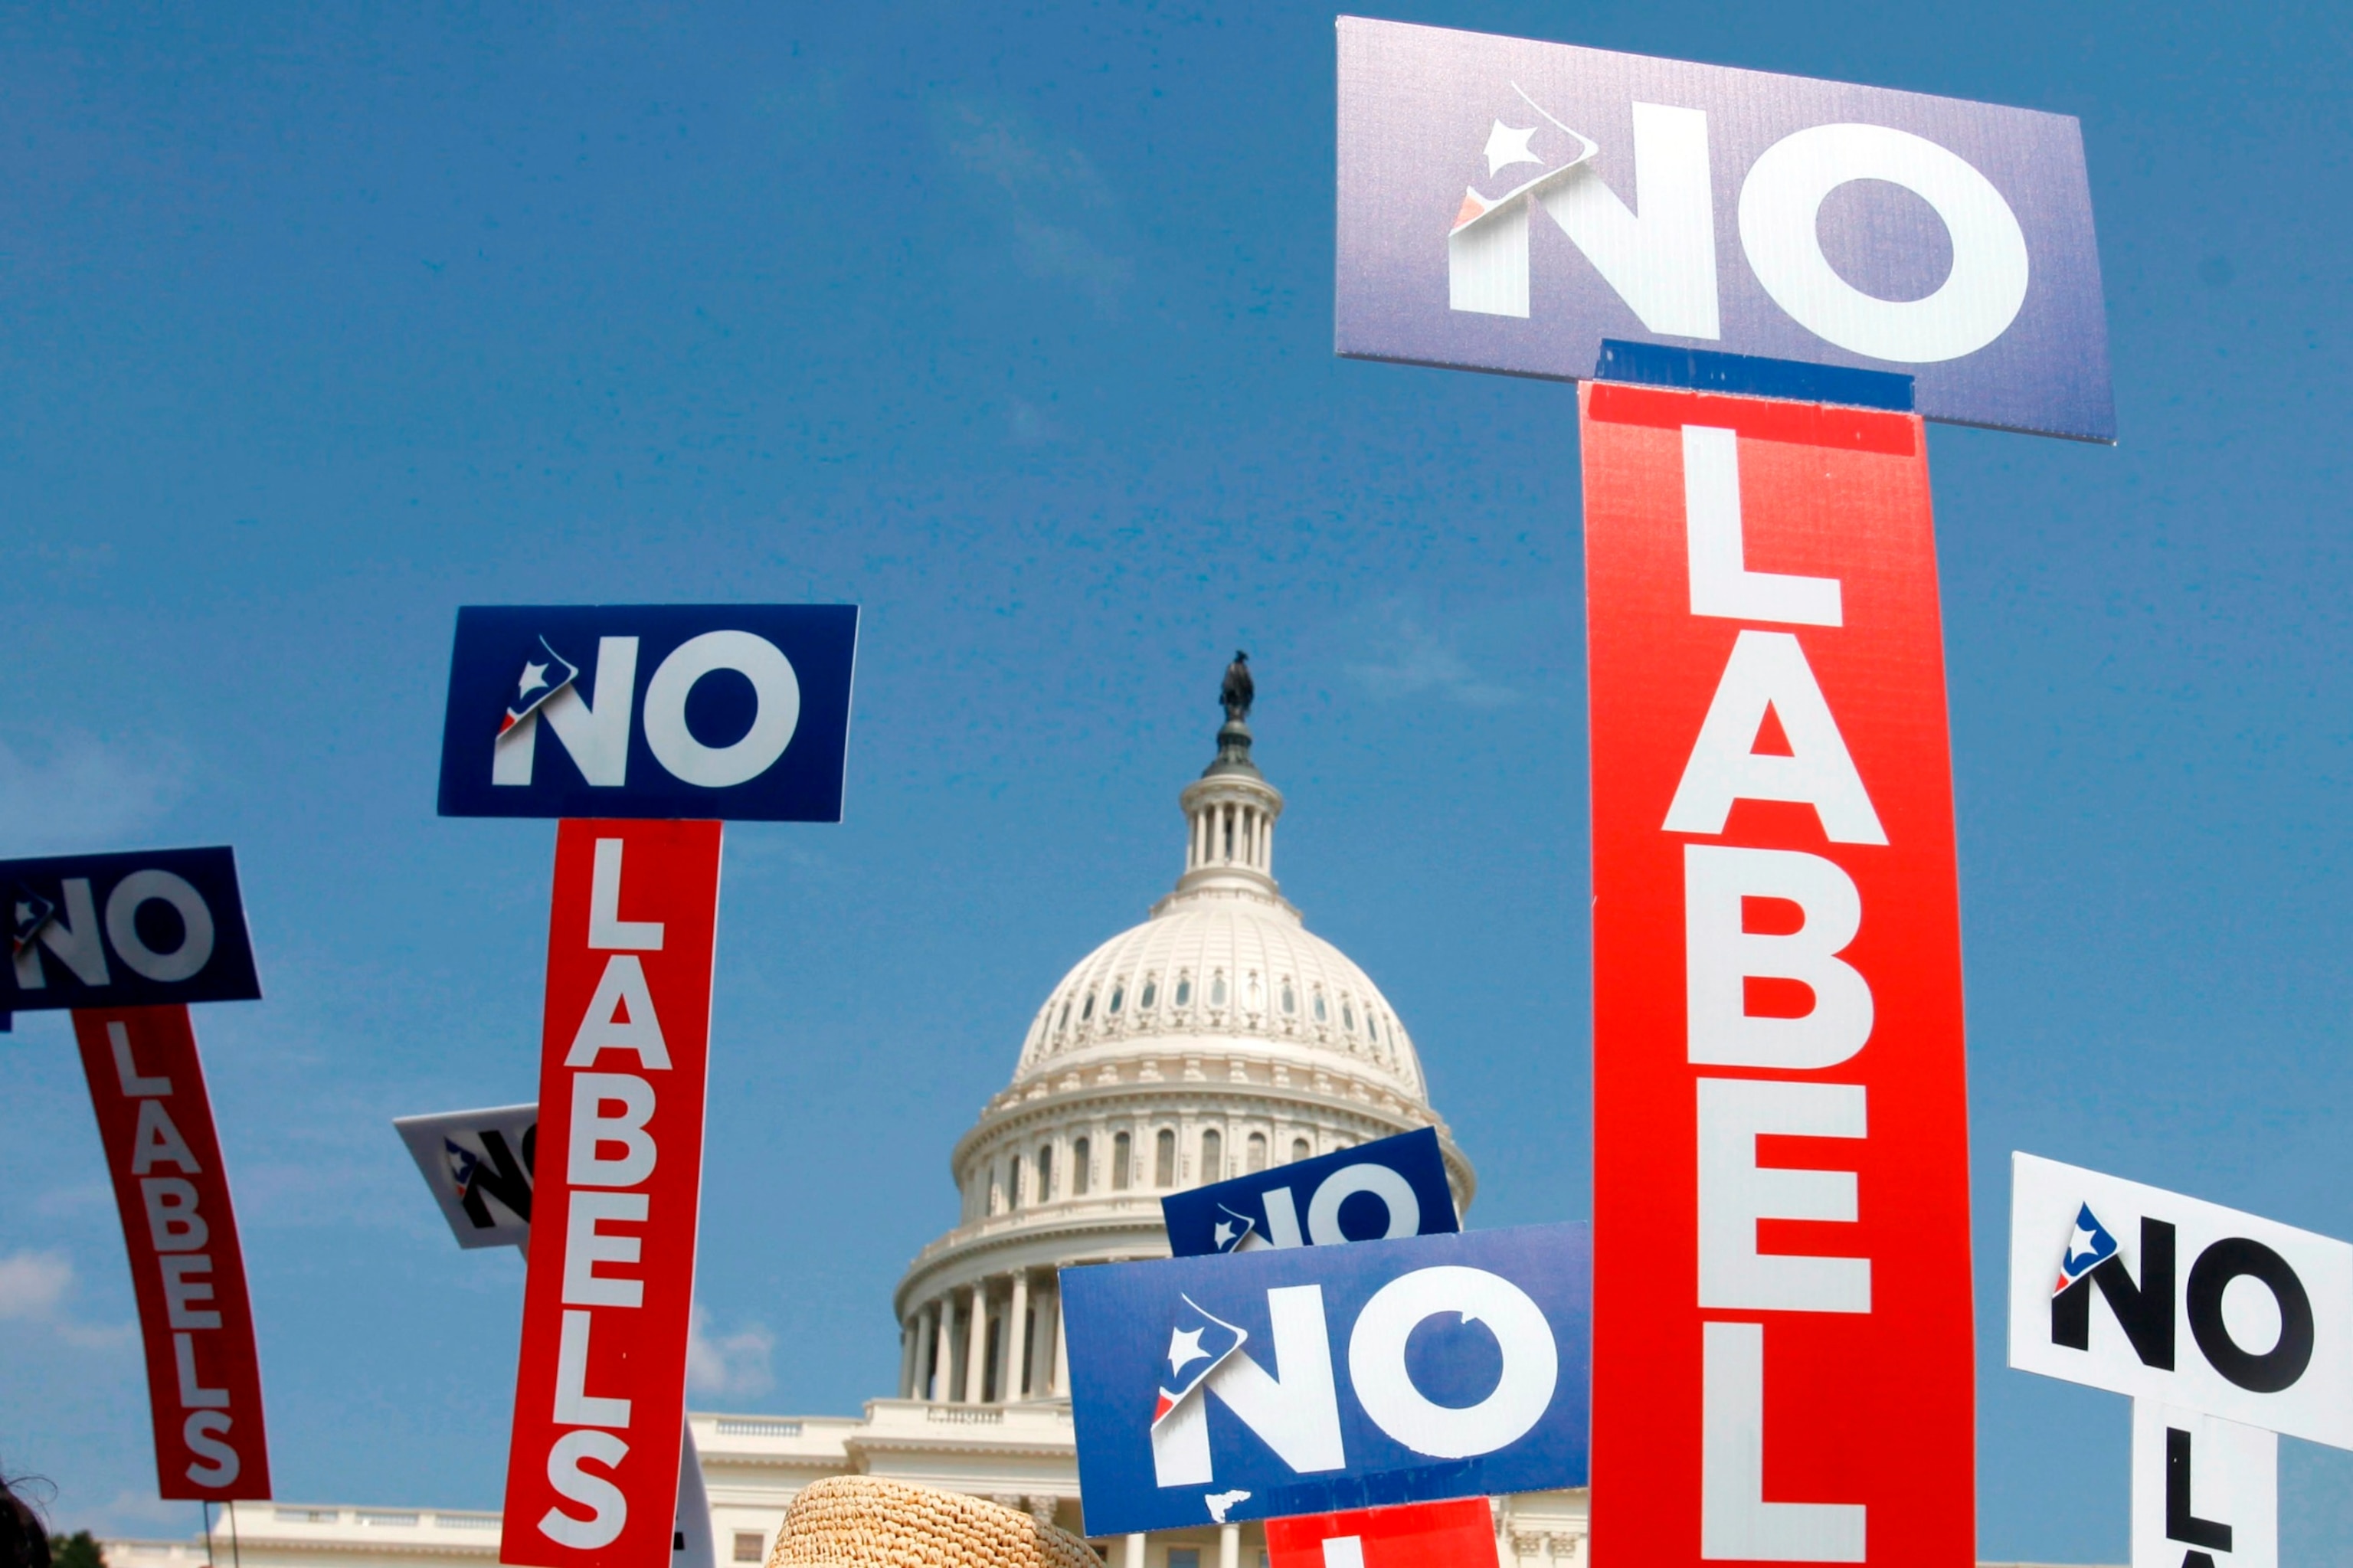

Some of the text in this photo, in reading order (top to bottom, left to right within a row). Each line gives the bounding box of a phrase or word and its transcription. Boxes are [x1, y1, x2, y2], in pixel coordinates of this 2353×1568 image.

[1448, 100, 2029, 363] NO
[491, 629, 800, 787] NO
[11, 869, 215, 990] NO
[106, 1021, 241, 1488] LABELS
[536, 837, 673, 1550] LABELS
[2051, 1215, 2315, 1393] NO
[1150, 1265, 1559, 1488] NO
